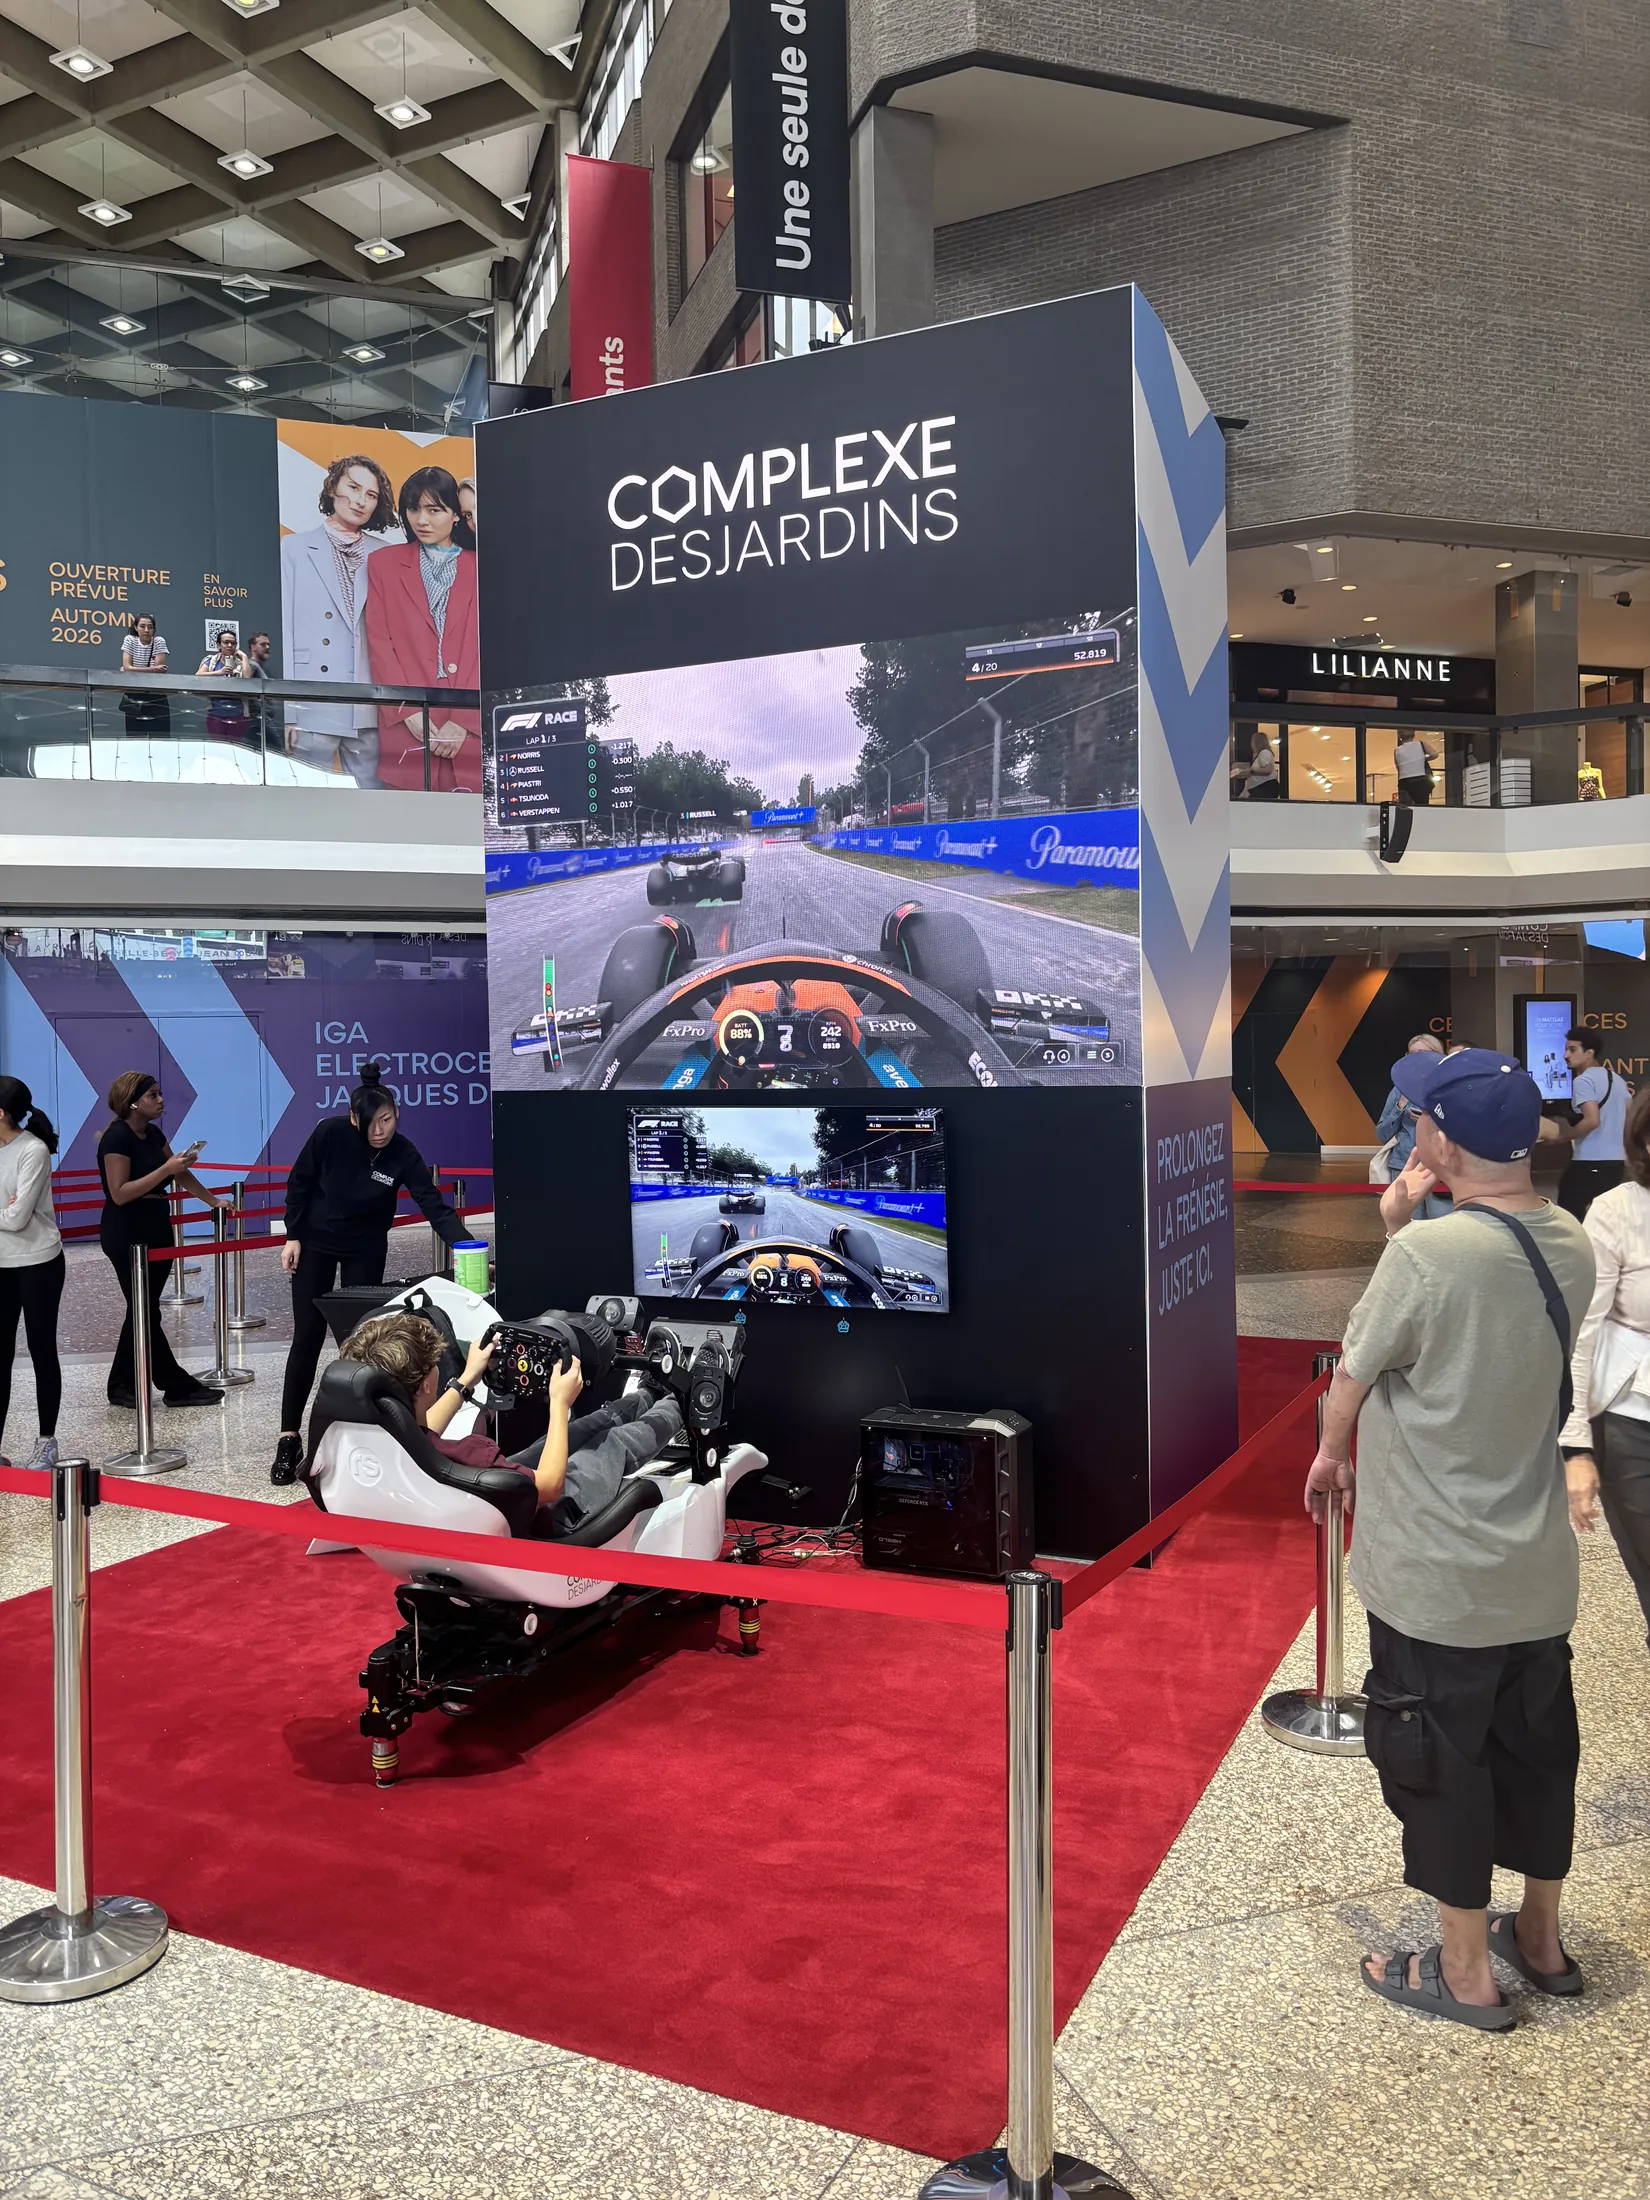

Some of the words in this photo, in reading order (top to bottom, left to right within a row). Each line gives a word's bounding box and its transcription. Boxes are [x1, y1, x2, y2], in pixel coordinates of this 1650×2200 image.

[770, 0, 807, 35] d
[772, 46, 810, 168] seule
[775, 180, 812, 270] Une
[608, 415, 957, 530] COMPLEXE
[611, 488, 959, 591] DESJARDINS
[49, 561, 171, 586] OUVERTURE
[203, 574, 220, 585] EN
[50, 580, 129, 602] PRÉVUE
[203, 586, 248, 599] SAVOIR
[204, 597, 234, 609] PLUS
[51, 607, 154, 628] AUTOMN
[51, 627, 102, 645] 2026
[1074, 649, 1107, 660] 52.819
[1313, 652, 1450, 681] LILIANNE
[545, 711, 577, 725] RACE
[517, 752, 541, 760] NORRIS
[517, 766, 544, 774] RUSSELL
[518, 780, 542, 788] PIASTRI
[519, 794, 549, 803] TSUNODA
[519, 808, 560, 817] VERSTAPPEN
[690, 810, 716, 818] RUSSELL
[764, 811, 804, 823] Paramount+
[857, 960, 893, 974] chrome
[866, 1019, 917, 1032] FxPro
[1583, 1012, 1628, 1029] CES
[315, 1021, 369, 1044] IGA
[662, 1025, 705, 1037] FxPro
[730, 1028, 752, 1039] 88%
[821, 1026, 842, 1037] 242
[316, 1052, 490, 1077] ELECTROCE
[315, 1083, 459, 1109] JAUES
[468, 1083, 488, 1105] D
[1157, 1122, 1225, 1184] PROLONGEZ
[1158, 1201, 1175, 1250] LA
[1176, 1173, 1229, 1241] FRÉNÉSIE,
[823, 1274, 848, 1283] FxPro
[1158, 1252, 1194, 1316] JUSTE
[1196, 1242, 1214, 1291] ICI.
